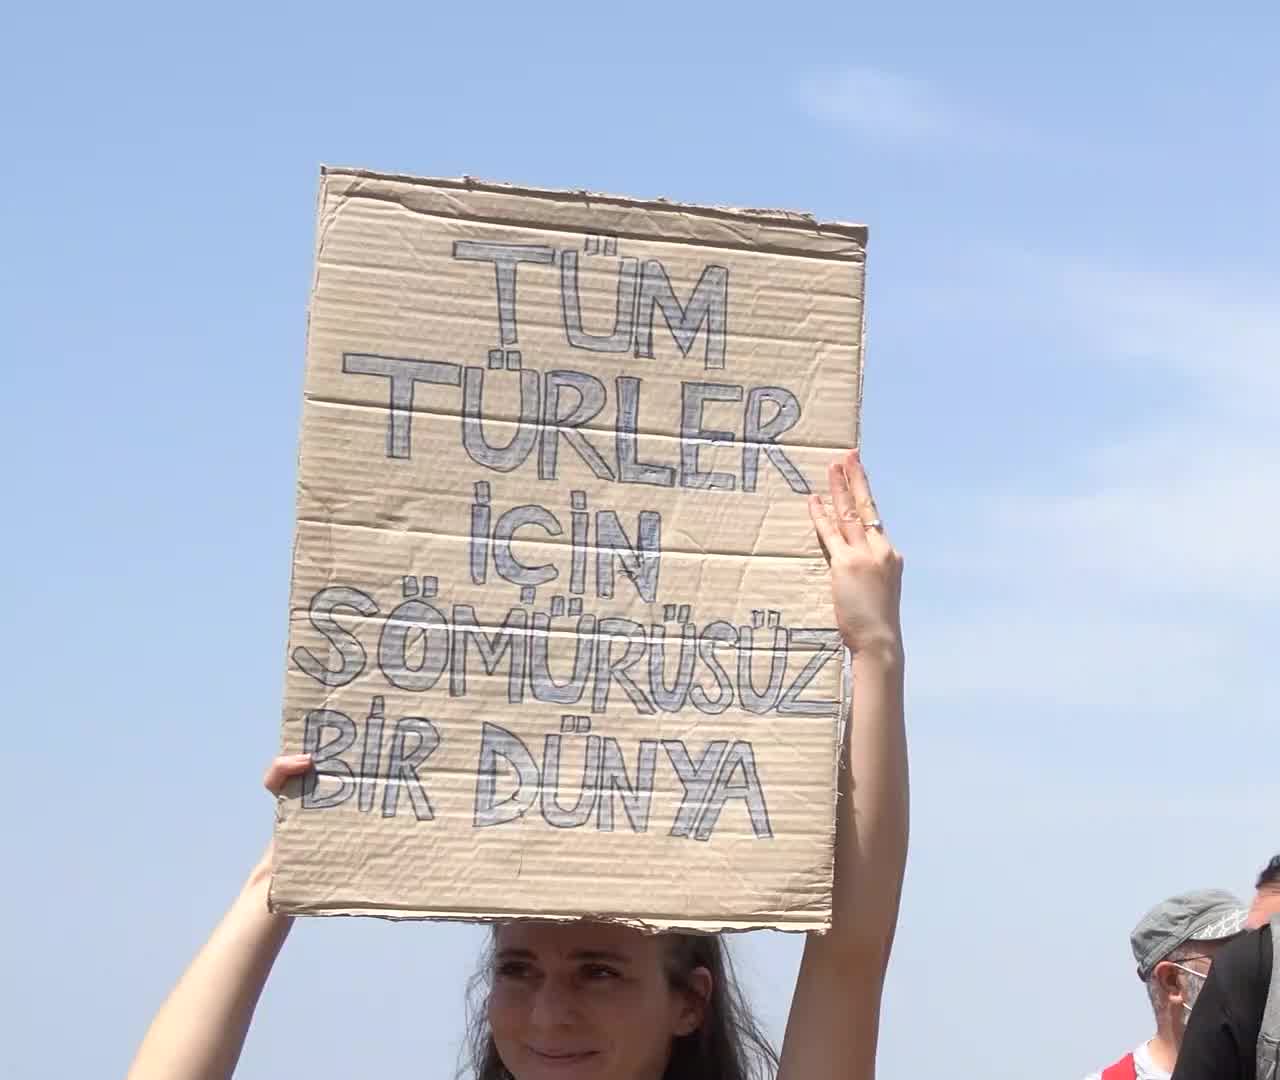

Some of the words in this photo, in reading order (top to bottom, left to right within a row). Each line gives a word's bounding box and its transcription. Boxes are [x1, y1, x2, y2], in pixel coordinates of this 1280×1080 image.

[452, 236, 730, 370] TÜM
[341, 350, 812, 495] TÜRLER
[469, 480, 662, 603] İÇİN
[291, 576, 848, 717] SÖMÜRÜSÜZ
[301, 696, 441, 821] BİR
[472, 715, 774, 841] DÜNYA
